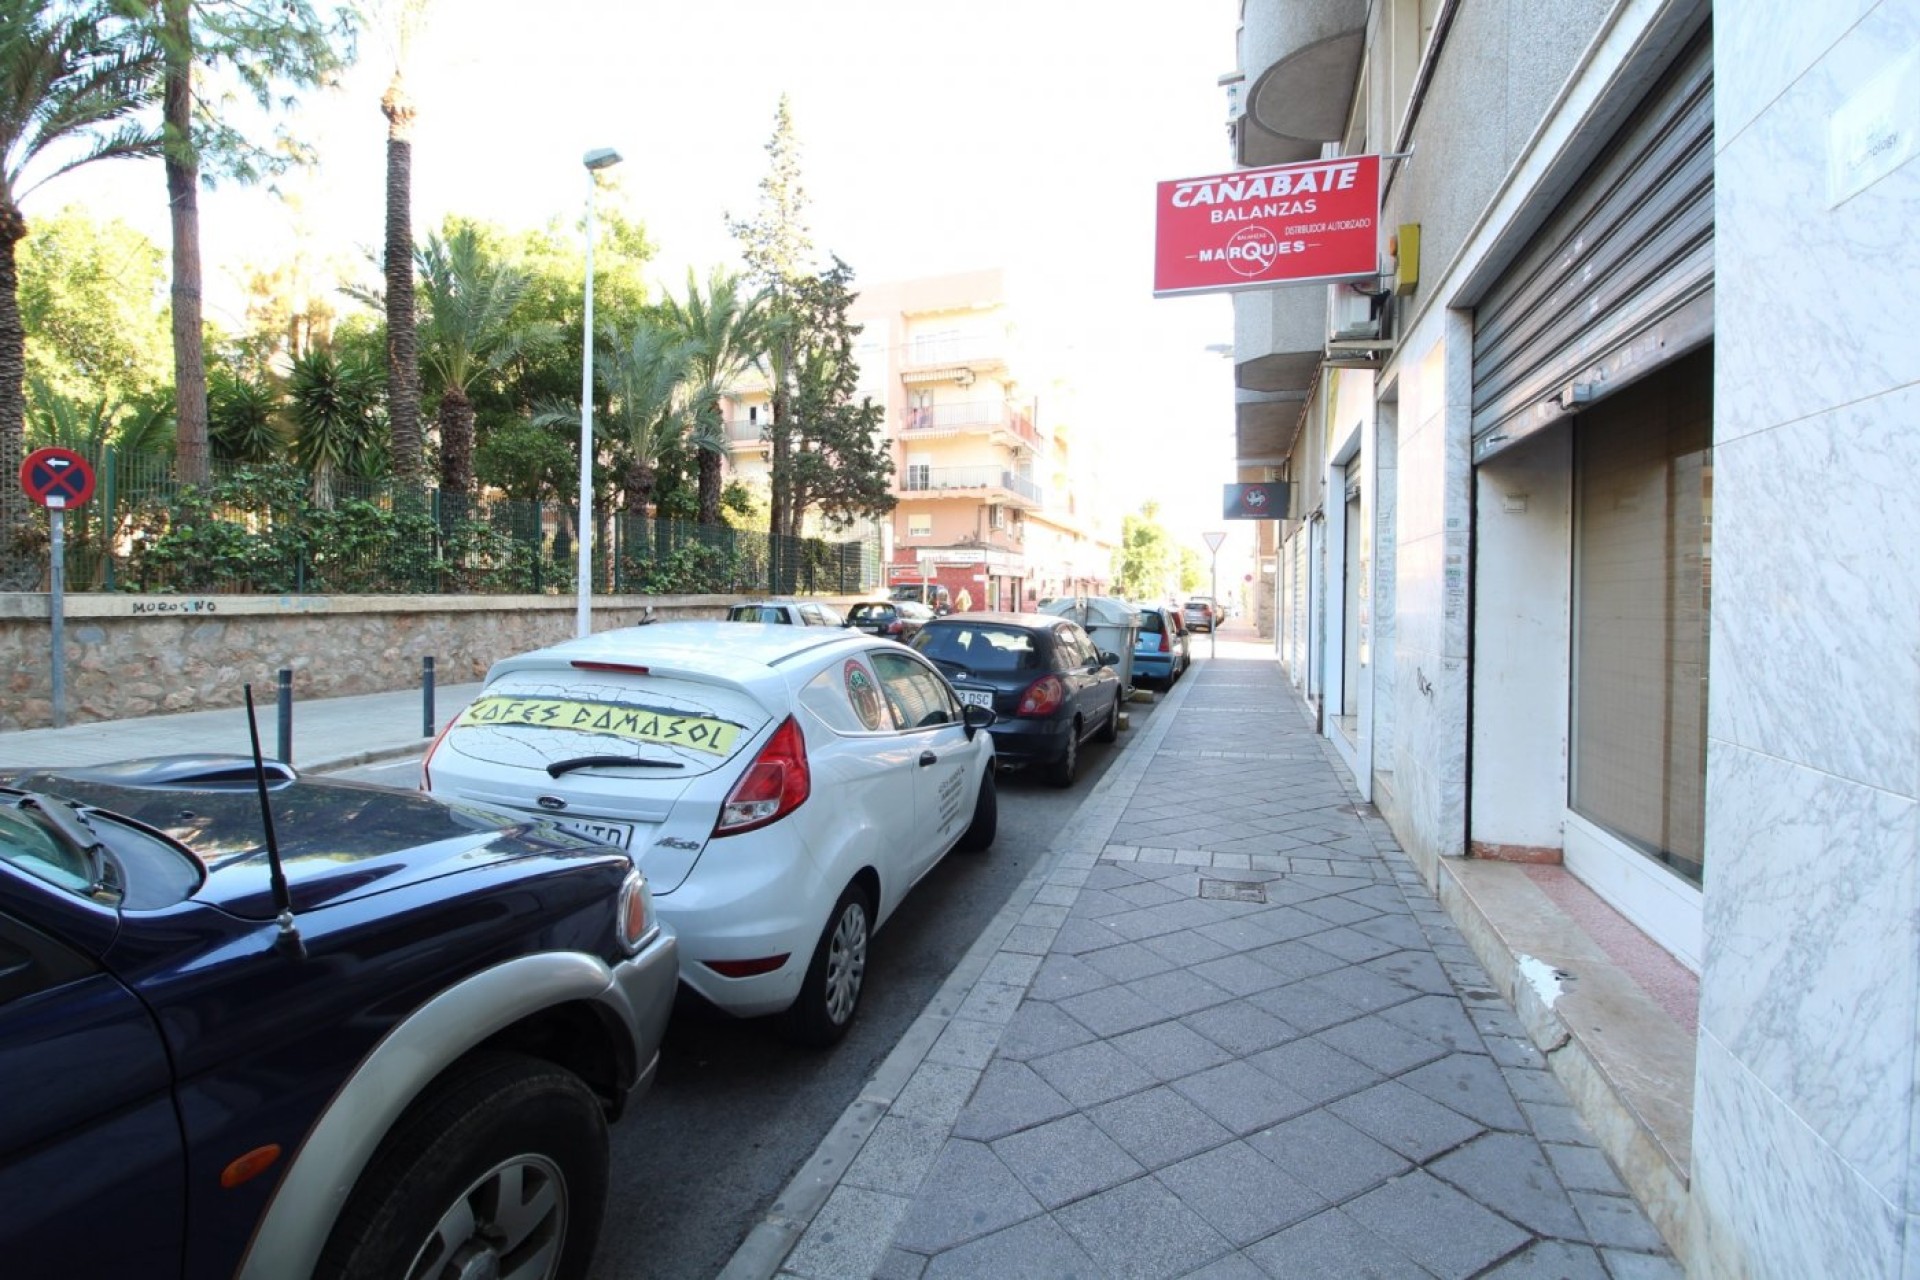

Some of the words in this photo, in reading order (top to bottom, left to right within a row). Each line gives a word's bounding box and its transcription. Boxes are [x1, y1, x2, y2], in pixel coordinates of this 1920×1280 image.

[1172, 162, 1359, 208] CAÑABATE
[1210, 199, 1317, 225] BALANZAS
[1285, 222, 1327, 236] DISTRIBUIDOR
[1327, 217, 1371, 232] AUTORIZADO
[1198, 240, 1306, 266] MARQUES
